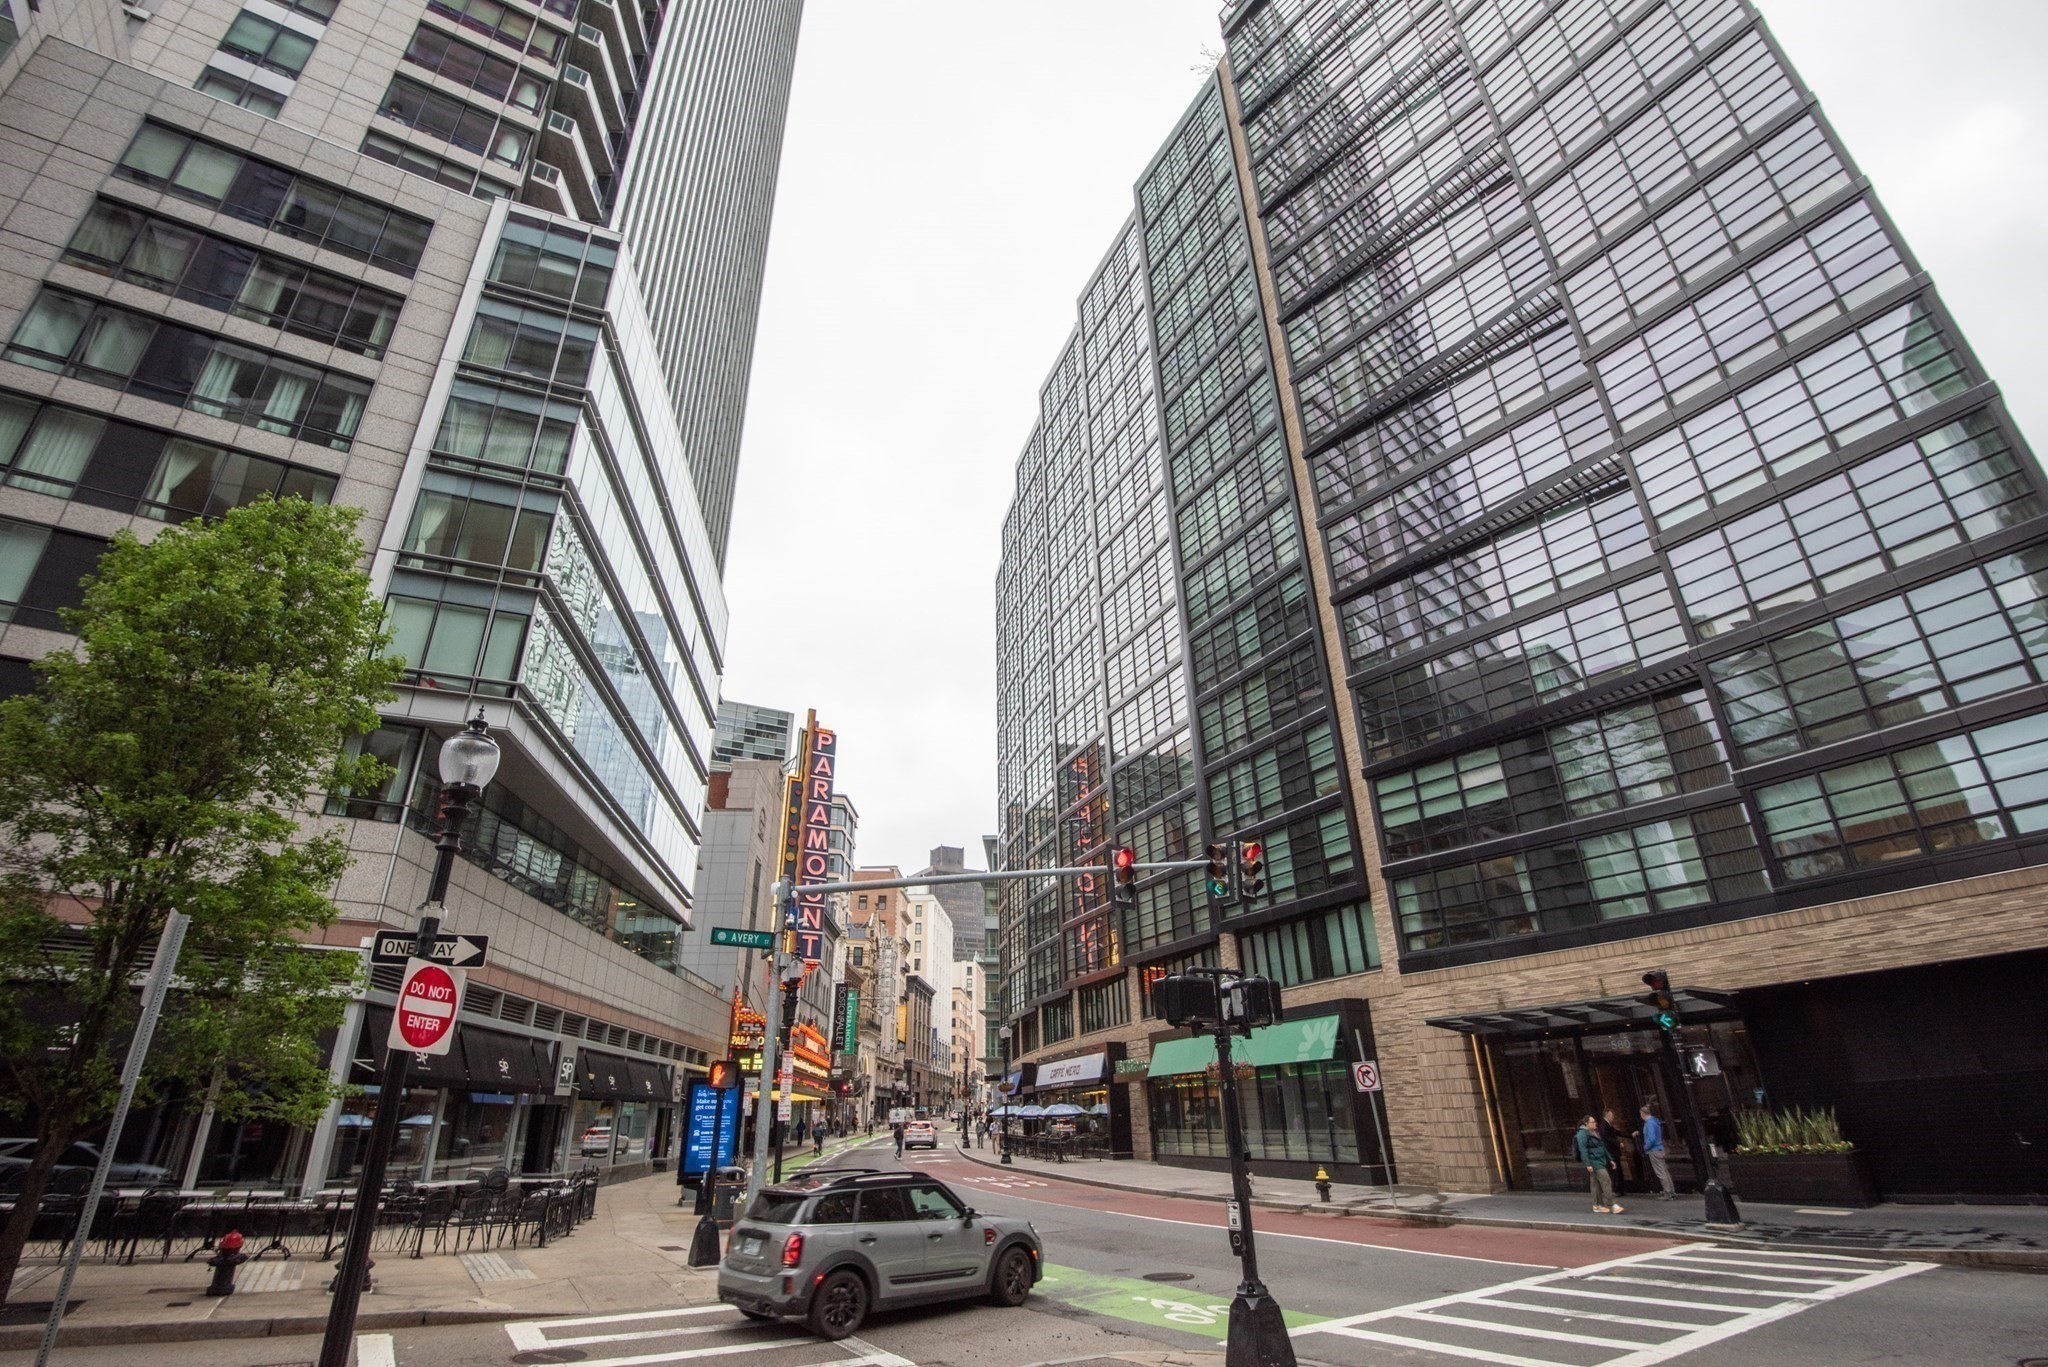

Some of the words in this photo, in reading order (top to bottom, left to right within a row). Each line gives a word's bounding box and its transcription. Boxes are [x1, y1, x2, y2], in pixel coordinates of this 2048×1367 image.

[801, 732, 834, 958] PARAMOUNT
[730, 932, 760, 944] AVERY
[384, 940, 416, 955] ONE
[410, 981, 426, 996] DO
[428, 984, 453, 1001] NOT
[406, 1014, 441, 1032] ENTER
[1610, 1039, 1631, 1050] 580
